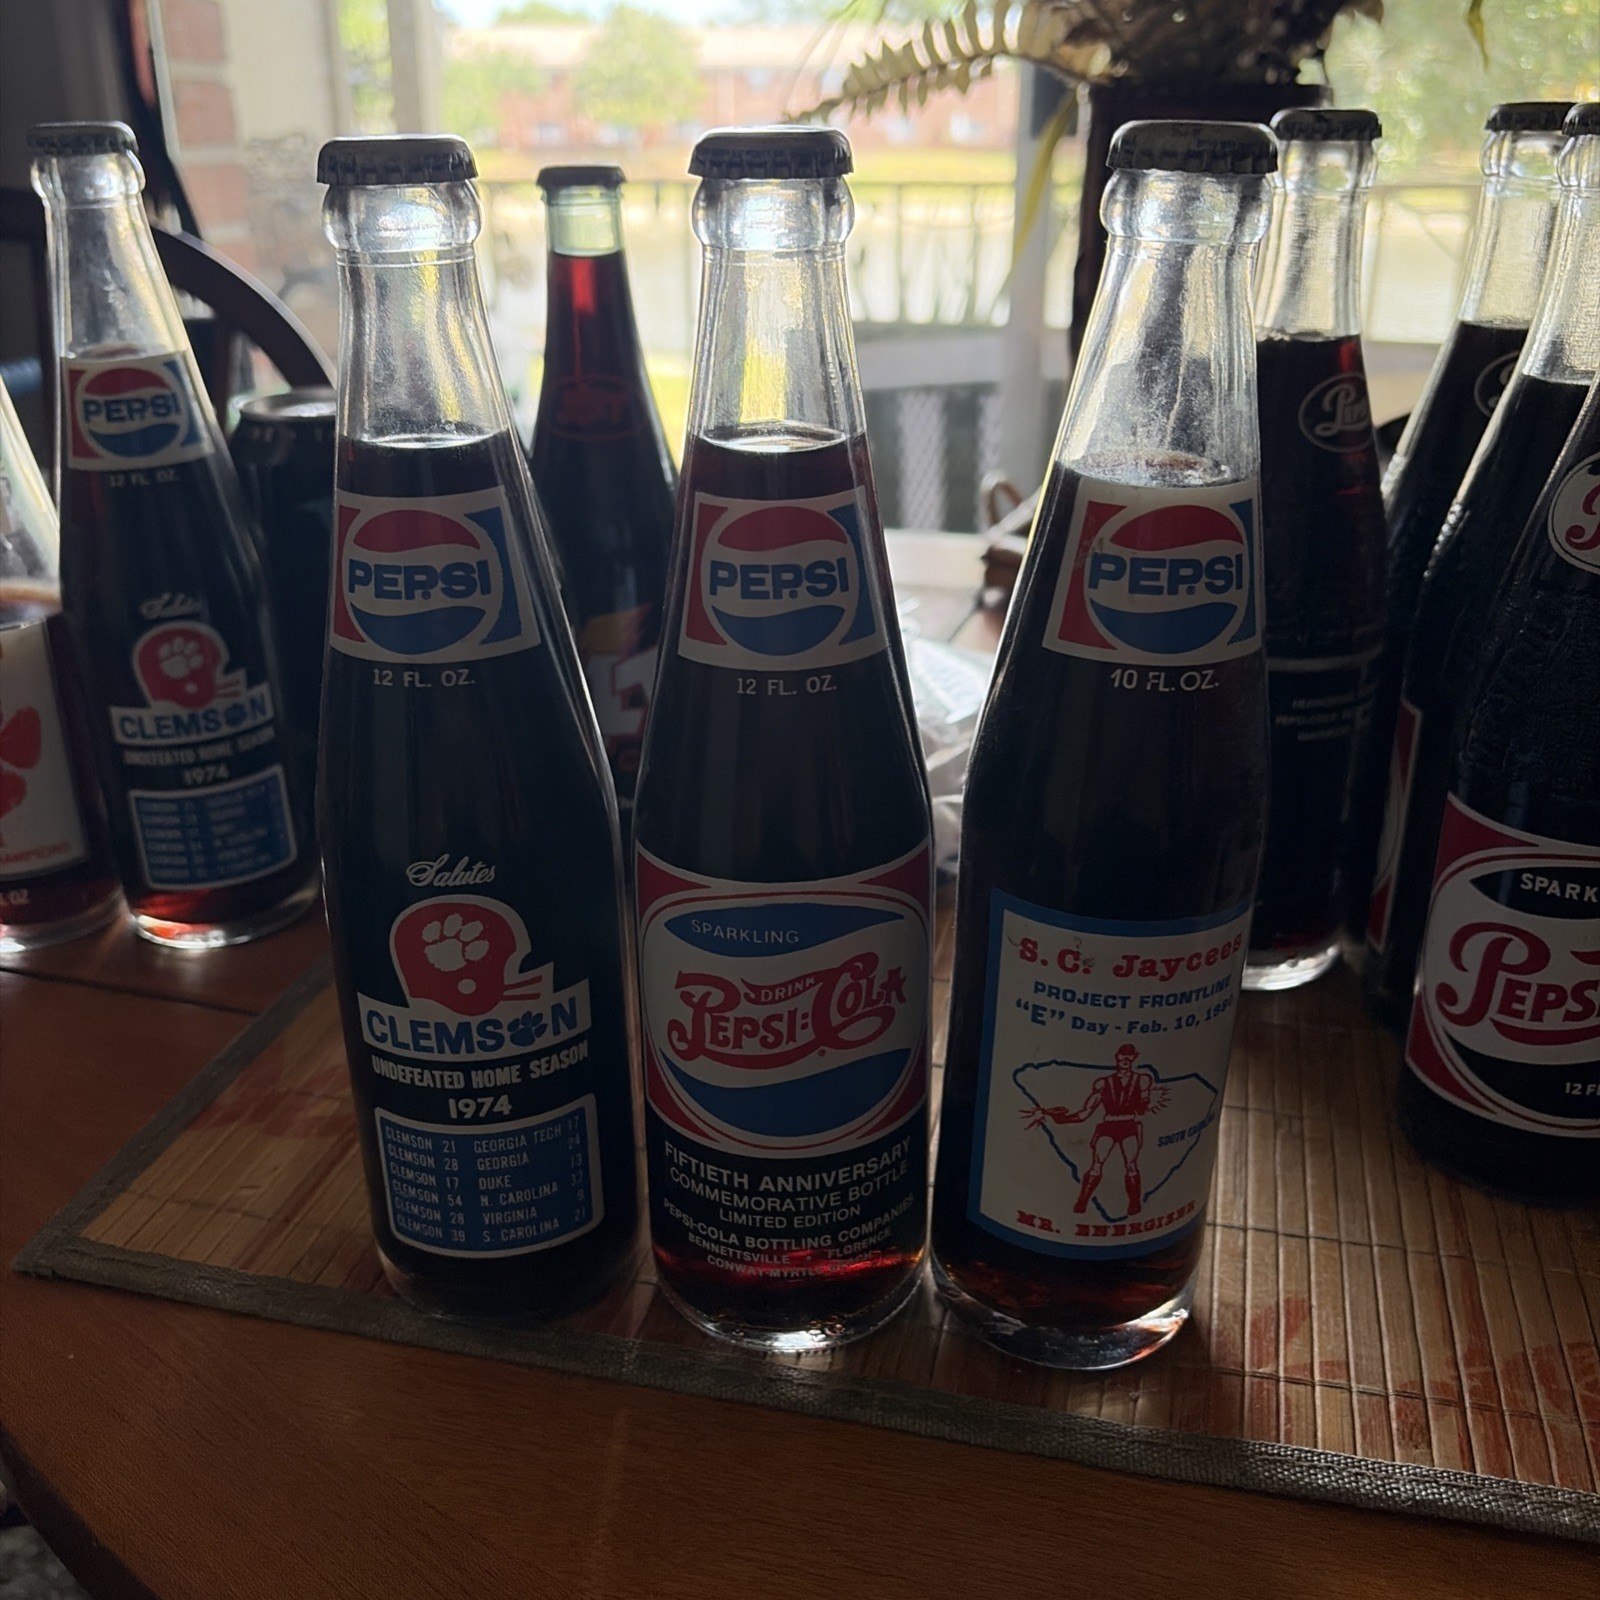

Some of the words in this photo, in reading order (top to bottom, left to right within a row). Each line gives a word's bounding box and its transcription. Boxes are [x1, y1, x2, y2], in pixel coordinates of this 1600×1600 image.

[83, 392, 181, 424] PEPSI
[348, 559, 492, 600] PEPSI
[709, 557, 850, 600] PEPSI
[1088, 552, 1243, 596] PEPSI
[372, 668, 393, 686] 12
[403, 671, 433, 689] FL.
[441, 667, 476, 687] OZ.
[736, 678, 757, 696] 12
[767, 679, 798, 697] FL.
[806, 674, 837, 693] OZ.
[1110, 668, 1138, 689] 10
[1146, 671, 1175, 692] FL.
[1180, 669, 1220, 691] OZ.
[405, 853, 497, 887] Salutes
[691, 919, 801, 943] SPARKLING
[1112, 932, 1243, 982] Jaycees
[760, 976, 816, 1002] DRINK
[1434, 921, 1600, 1028] PEPS
[1033, 980, 1131, 1009] PROJECT
[1138, 973, 1232, 1009] FRONTLINE
[1071, 1016, 1110, 1036] Day
[1127, 1020, 1168, 1035] Feb.
[1174, 1013, 1200, 1030] 10,
[371, 1054, 465, 1090] UNDEFEATED
[471, 1063, 522, 1090] HOME
[529, 1039, 589, 1079] SEASON
[1564, 1080, 1583, 1096] 12
[448, 1094, 513, 1119] 1974
[385, 1126, 433, 1151] CLEMSON
[443, 1140, 456, 1154] 21
[474, 1134, 528, 1154] GEORGIA
[533, 1124, 562, 1144] TECH
[387, 1143, 436, 1169] CLEMSON
[444, 1158, 459, 1171] 28
[476, 1152, 530, 1171] GEORGIA
[664, 1140, 749, 1191] FIFTIETH
[758, 1134, 911, 1193] ANNIVERSARY
[389, 1161, 437, 1187] CLEMSON
[446, 1176, 460, 1190] 17
[478, 1175, 513, 1191] DUKE
[669, 1166, 842, 1213] COMMEMORATIVE
[848, 1159, 909, 1202] BOTTLE
[392, 1179, 439, 1204] CLEMSON
[447, 1194, 463, 1207] 54
[500, 1181, 559, 1205] CAROLINA
[394, 1196, 442, 1222] CLEMSON
[450, 1211, 465, 1225] 28
[482, 1206, 539, 1226] VIRGINIA
[663, 1197, 739, 1246] PEPSI-COLA
[745, 1234, 832, 1251] BOTTLING
[719, 1207, 787, 1230] LIMITED
[793, 1204, 862, 1229] EDITION
[1016, 1210, 1061, 1234] MR.
[396, 1213, 443, 1239] CLEMSON
[500, 1217, 561, 1240] CAROLINA
[687, 1232, 791, 1265] BENNETTSVILLE
[827, 1226, 892, 1260] FLORENCE
